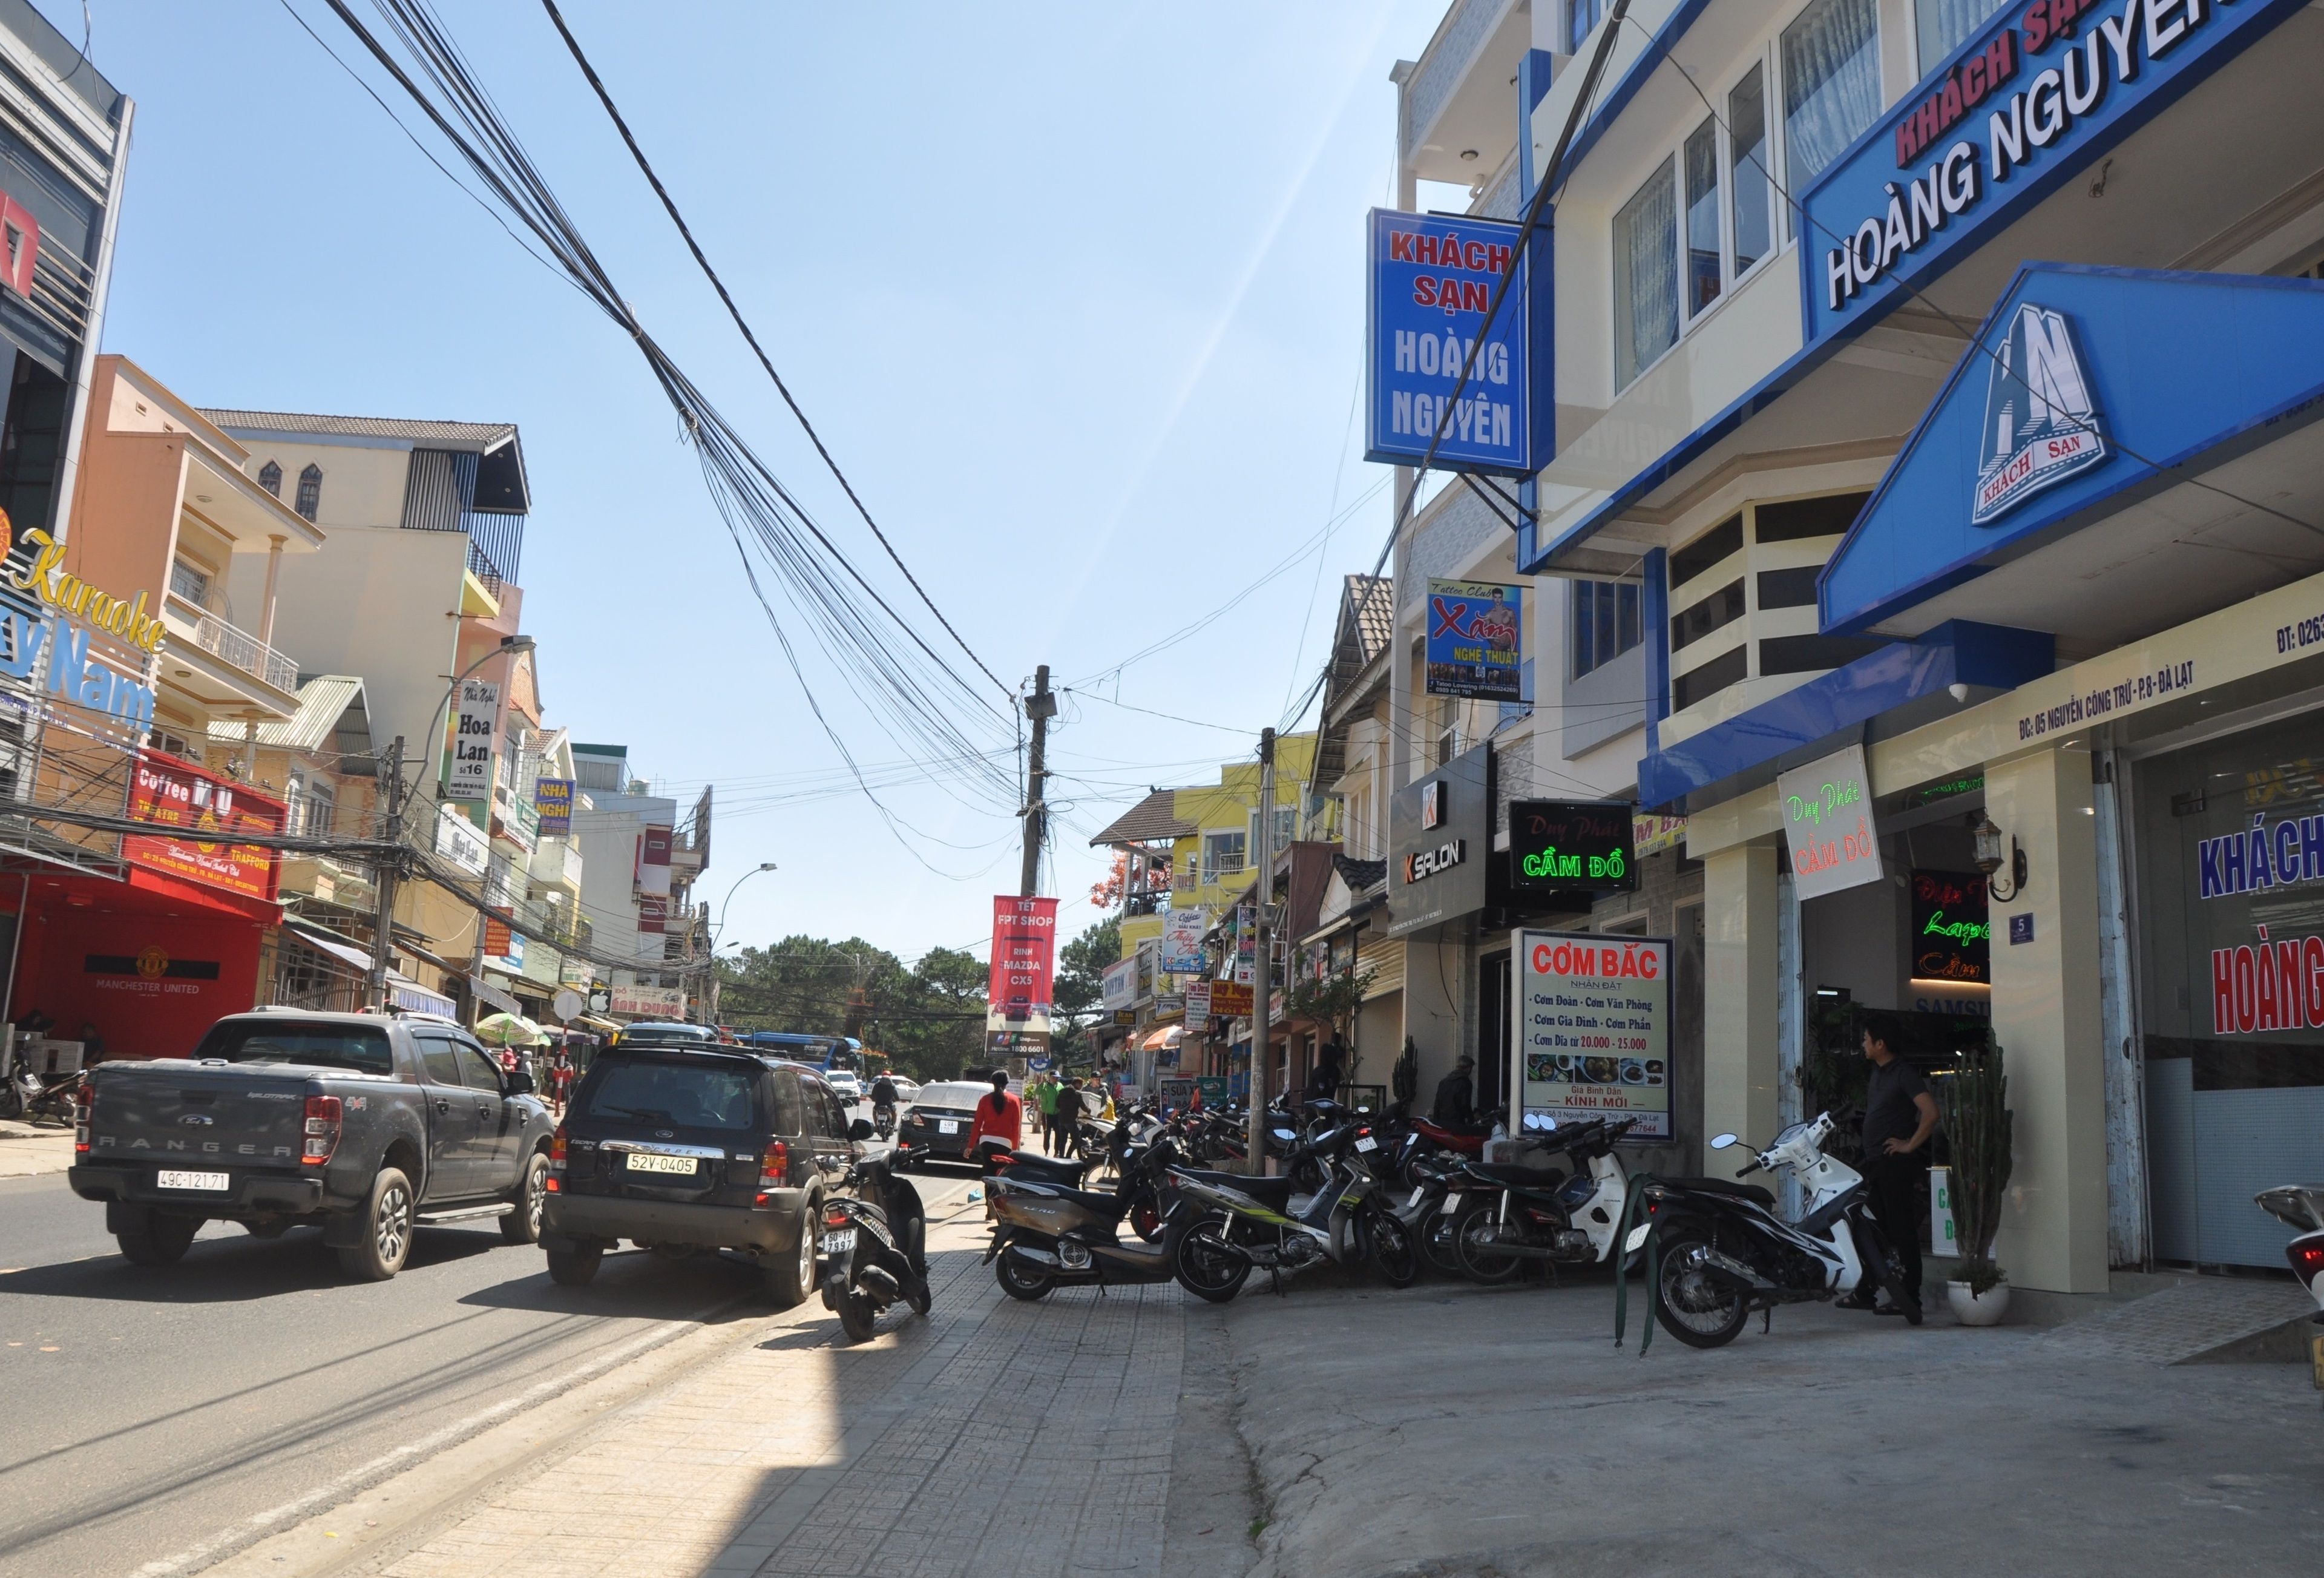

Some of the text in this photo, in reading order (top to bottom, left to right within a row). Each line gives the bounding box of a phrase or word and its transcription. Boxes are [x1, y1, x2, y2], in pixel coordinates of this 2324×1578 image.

[1895, 28, 2015, 169] KHÁCH
[1827, 141, 1978, 310] HOÀNG
[1390, 232, 1511, 275] KHÁCH
[1413, 275, 1489, 315] SẠN
[1395, 327, 1509, 385] HOÀNG
[1392, 390, 1511, 447] NGUYÊN
[1984, 436, 2081, 505] KHÁCH SẠN
[7, 527, 165, 654] Karaoke
[1432, 583, 1492, 597] Tattoo Club
[1433, 596, 1516, 652] Xăm
[2277, 625, 2296, 654] ĐT:
[1454, 646, 1518, 666] NGHỆ THUẬT
[48, 616, 154, 734] Nam
[2020, 717, 2034, 740] ĐC:
[2035, 712, 2046, 735] 05
[2048, 694, 2083, 730] NGUYỄN
[2086, 689, 2111, 718] CÔNG
[2113, 677, 2132, 709] TRỨ
[2158, 664, 2173, 694] ĐÀ
[2175, 660, 2193, 690] LẠT
[458, 714, 490, 735] Hoa
[456, 740, 488, 761] Lan
[467, 764, 482, 775] 16
[139, 768, 189, 801] Coffee
[539, 781, 569, 798] NHÀ
[536, 801, 570, 817] NGHỈ
[1787, 780, 1860, 825] Duy Phát
[1796, 816, 1871, 875] CẦM ĐỒ
[2198, 812, 2324, 899] KHÁCH
[231, 849, 270, 872] TRAFFORD
[1523, 846, 1625, 878] CẦM ĐỒ
[1017, 898, 1036, 912] TẾT
[998, 915, 1054, 927] FPT SHOP
[2018, 918, 2025, 932] 5
[1003, 961, 1040, 970] MAZDA
[1532, 941, 1658, 979] CƠM BẮC
[96, 979, 199, 994] MANCHESTER UNITED
[1010, 976, 1032, 985] CX5
[1571, 979, 1623, 991] NHẬN ĐẶT
[2211, 924, 2324, 1034] HOÀNG
[1534, 994, 1554, 1005] Cơm
[1585, 996, 1604, 1008] Cơm
[1607, 998, 1624, 1009] Văn
[1626, 999, 1652, 1013] Phòng
[1535, 1014, 1555, 1025] Cơm
[1558, 1014, 1573, 1027] Gia
[1575, 1016, 1598, 1028] Đình
[1606, 1017, 1626, 1029] Cơm
[1581, 1036, 1610, 1048] 20.000
[1618, 1037, 1647, 1050] 25.000
[1565, 1096, 1627, 1108] KÍNH MỜI
[99, 1136, 292, 1157] RANGER
[632, 1156, 692, 1172] 52V-0405
[160, 1174, 226, 1189] 49C-121.71
[828, 1230, 852, 1243] 60-T7
[828, 1240, 852, 1252] 7997
